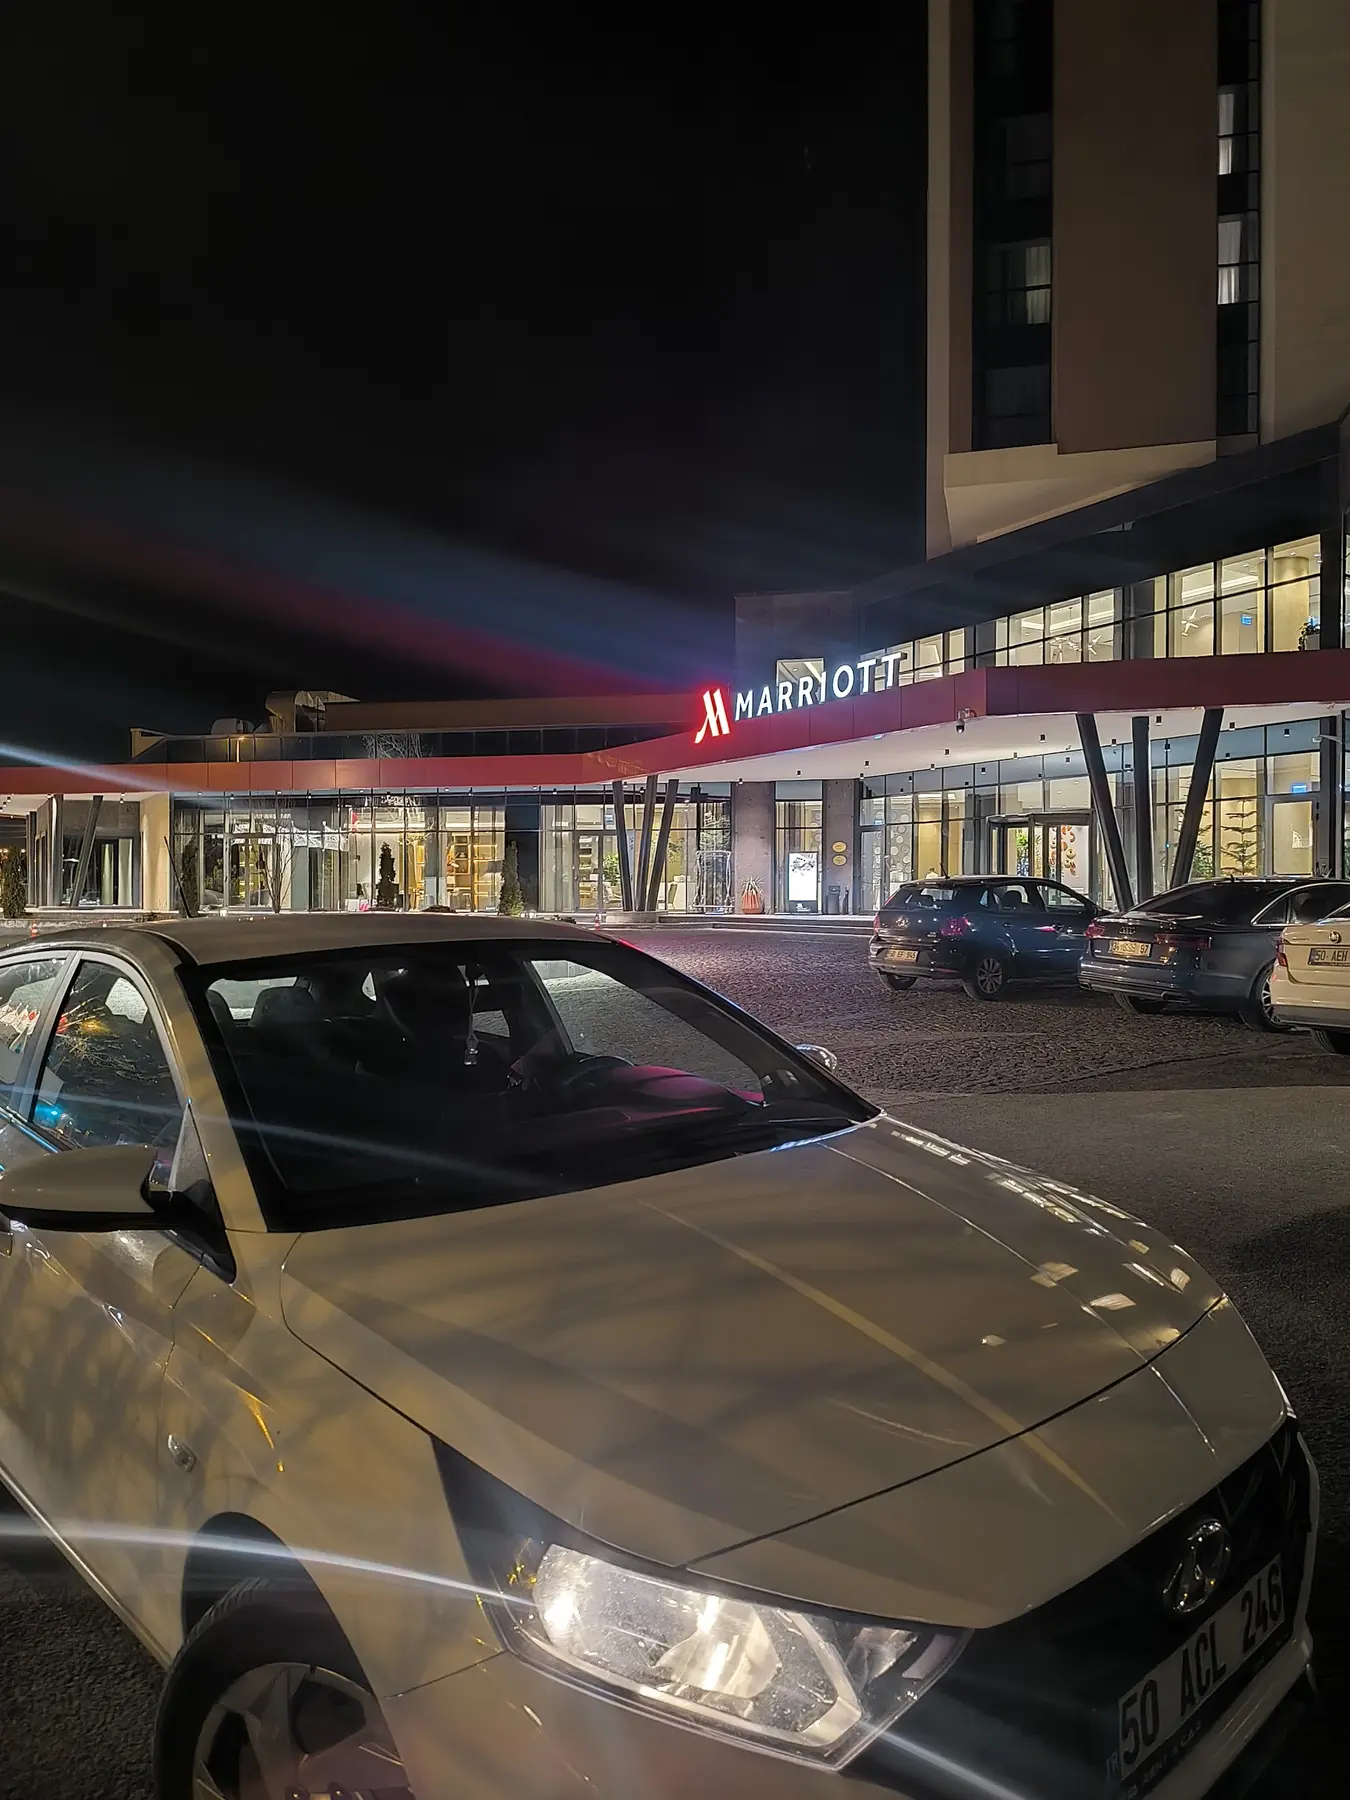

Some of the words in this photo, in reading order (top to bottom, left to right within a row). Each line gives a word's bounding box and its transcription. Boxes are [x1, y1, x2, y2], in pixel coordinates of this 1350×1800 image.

[735, 652, 905, 721] MARRIOTT
[1315, 950, 1326, 961] 50
[1121, 1679, 1159, 1765] 50
[1180, 1620, 1227, 1717] ACL
[1241, 1562, 1280, 1654] 246
